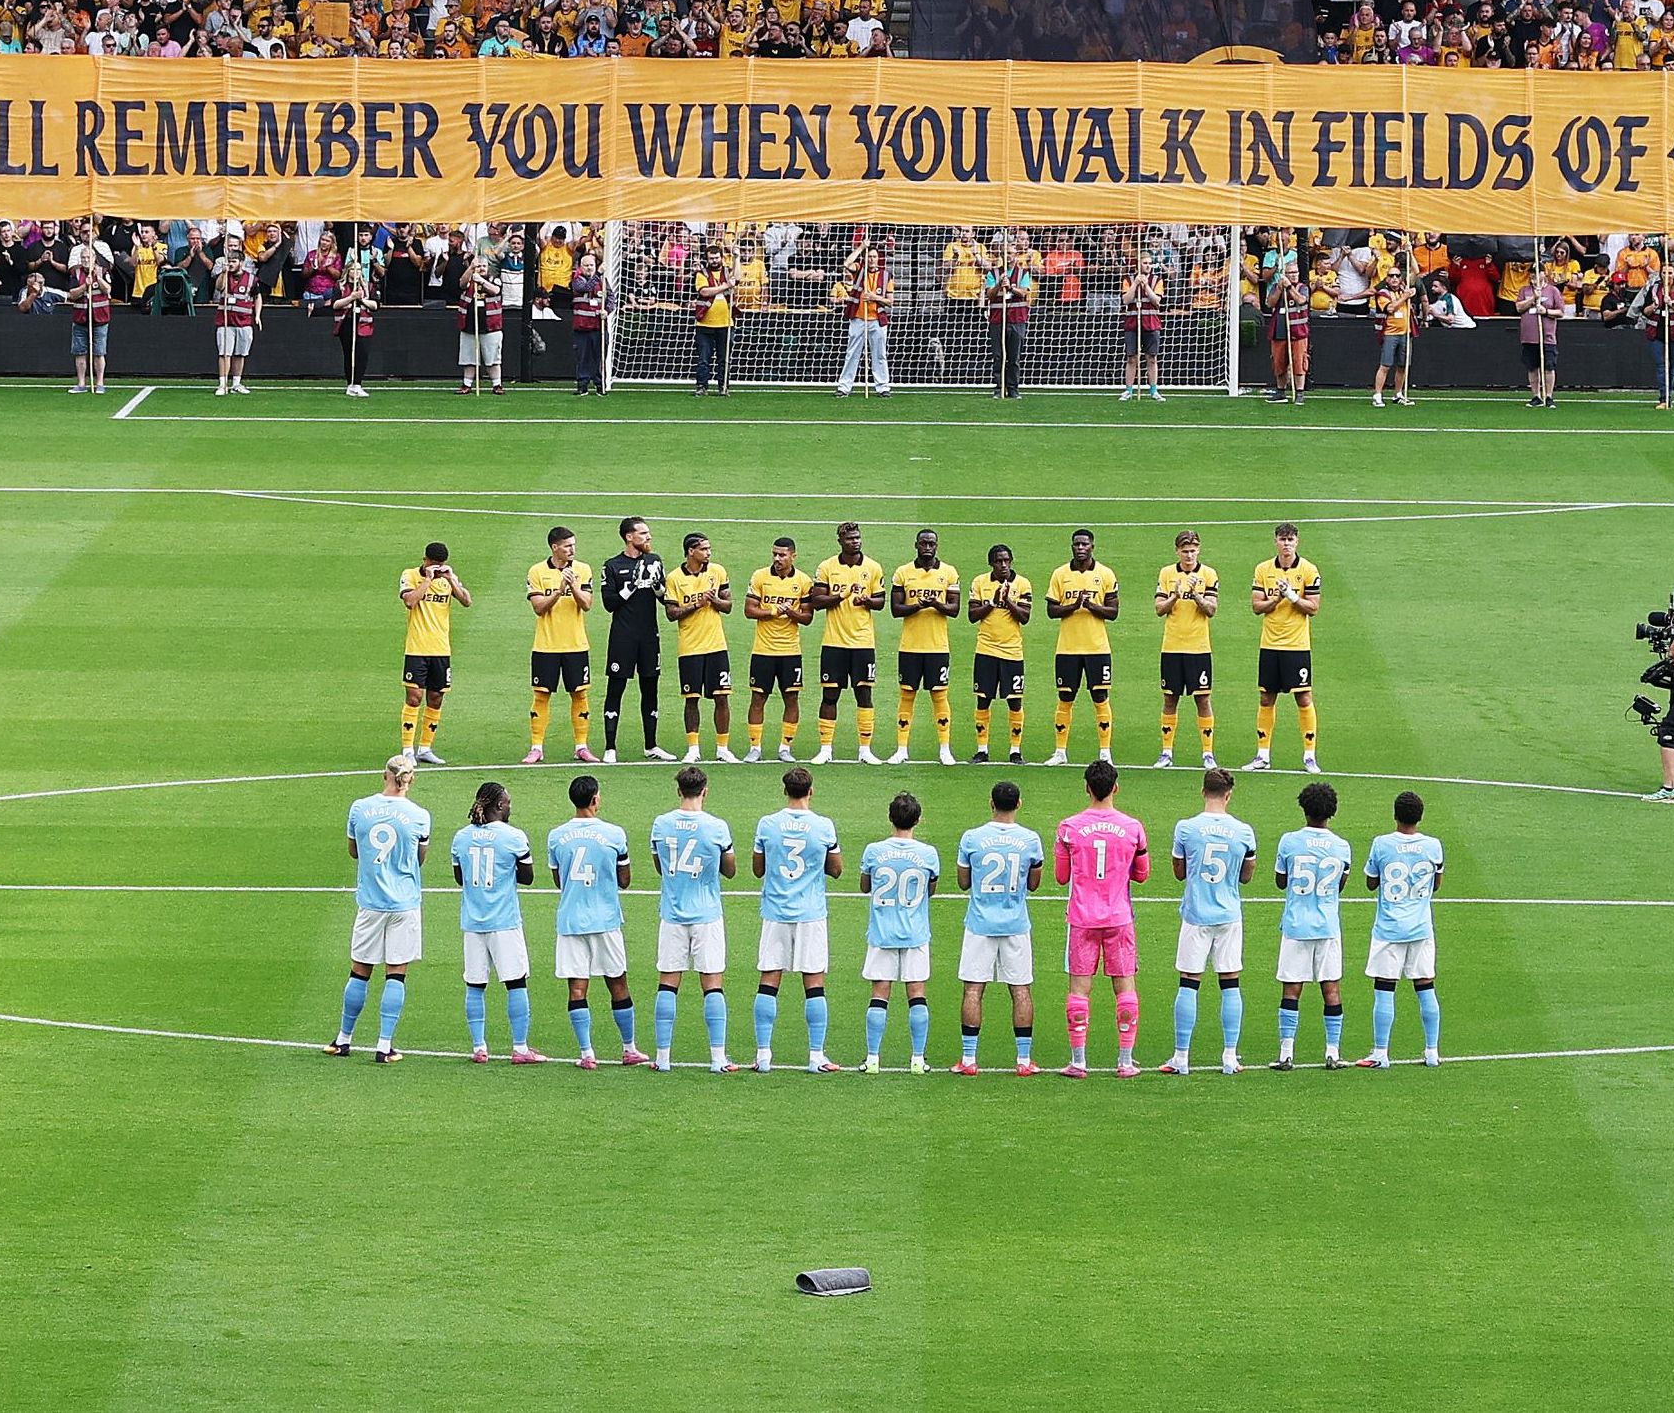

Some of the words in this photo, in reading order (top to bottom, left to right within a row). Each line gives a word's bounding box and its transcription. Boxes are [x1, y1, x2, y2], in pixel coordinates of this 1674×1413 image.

[76, 100, 442, 178] REMEMBER
[462, 103, 604, 180] YOU
[625, 103, 831, 181] WHEN
[850, 105, 991, 183] YOU
[1013, 107, 1206, 184] WALK
[1226, 110, 1294, 188] IN
[1311, 111, 1534, 191] FIELDS
[1551, 115, 1649, 193] OF
[832, 584, 866, 595] DEET
[1267, 586, 1299, 596] DET
[763, 594, 797, 606] DEBET
[583, 666, 590, 681] 2
[794, 668, 802, 682] 7
[1102, 666, 1111, 680] 5
[1198, 670, 1208, 685] 6
[1298, 667, 1308, 682] 9
[364, 809, 410, 825] HAALAND
[675, 820, 698, 832] NICO
[1079, 822, 1127, 838] TRAFFORD
[1199, 826, 1235, 838] STONES
[369, 822, 397, 864] 9
[472, 830, 495, 841] DOKU
[1306, 838, 1332, 849] BOBB
[1396, 843, 1423, 854] LEWIS
[665, 837, 703, 878] 14
[779, 838, 807, 879] 3
[876, 851, 925, 868] BERNARDO
[1093, 840, 1107, 880] 1
[1200, 843, 1229, 884] 5
[468, 847, 494, 887] 11
[570, 846, 595, 886] 4
[980, 852, 1021, 893] 21
[1292, 856, 1342, 898] 52
[1384, 861, 1437, 903] 82
[873, 867, 926, 908] 20
